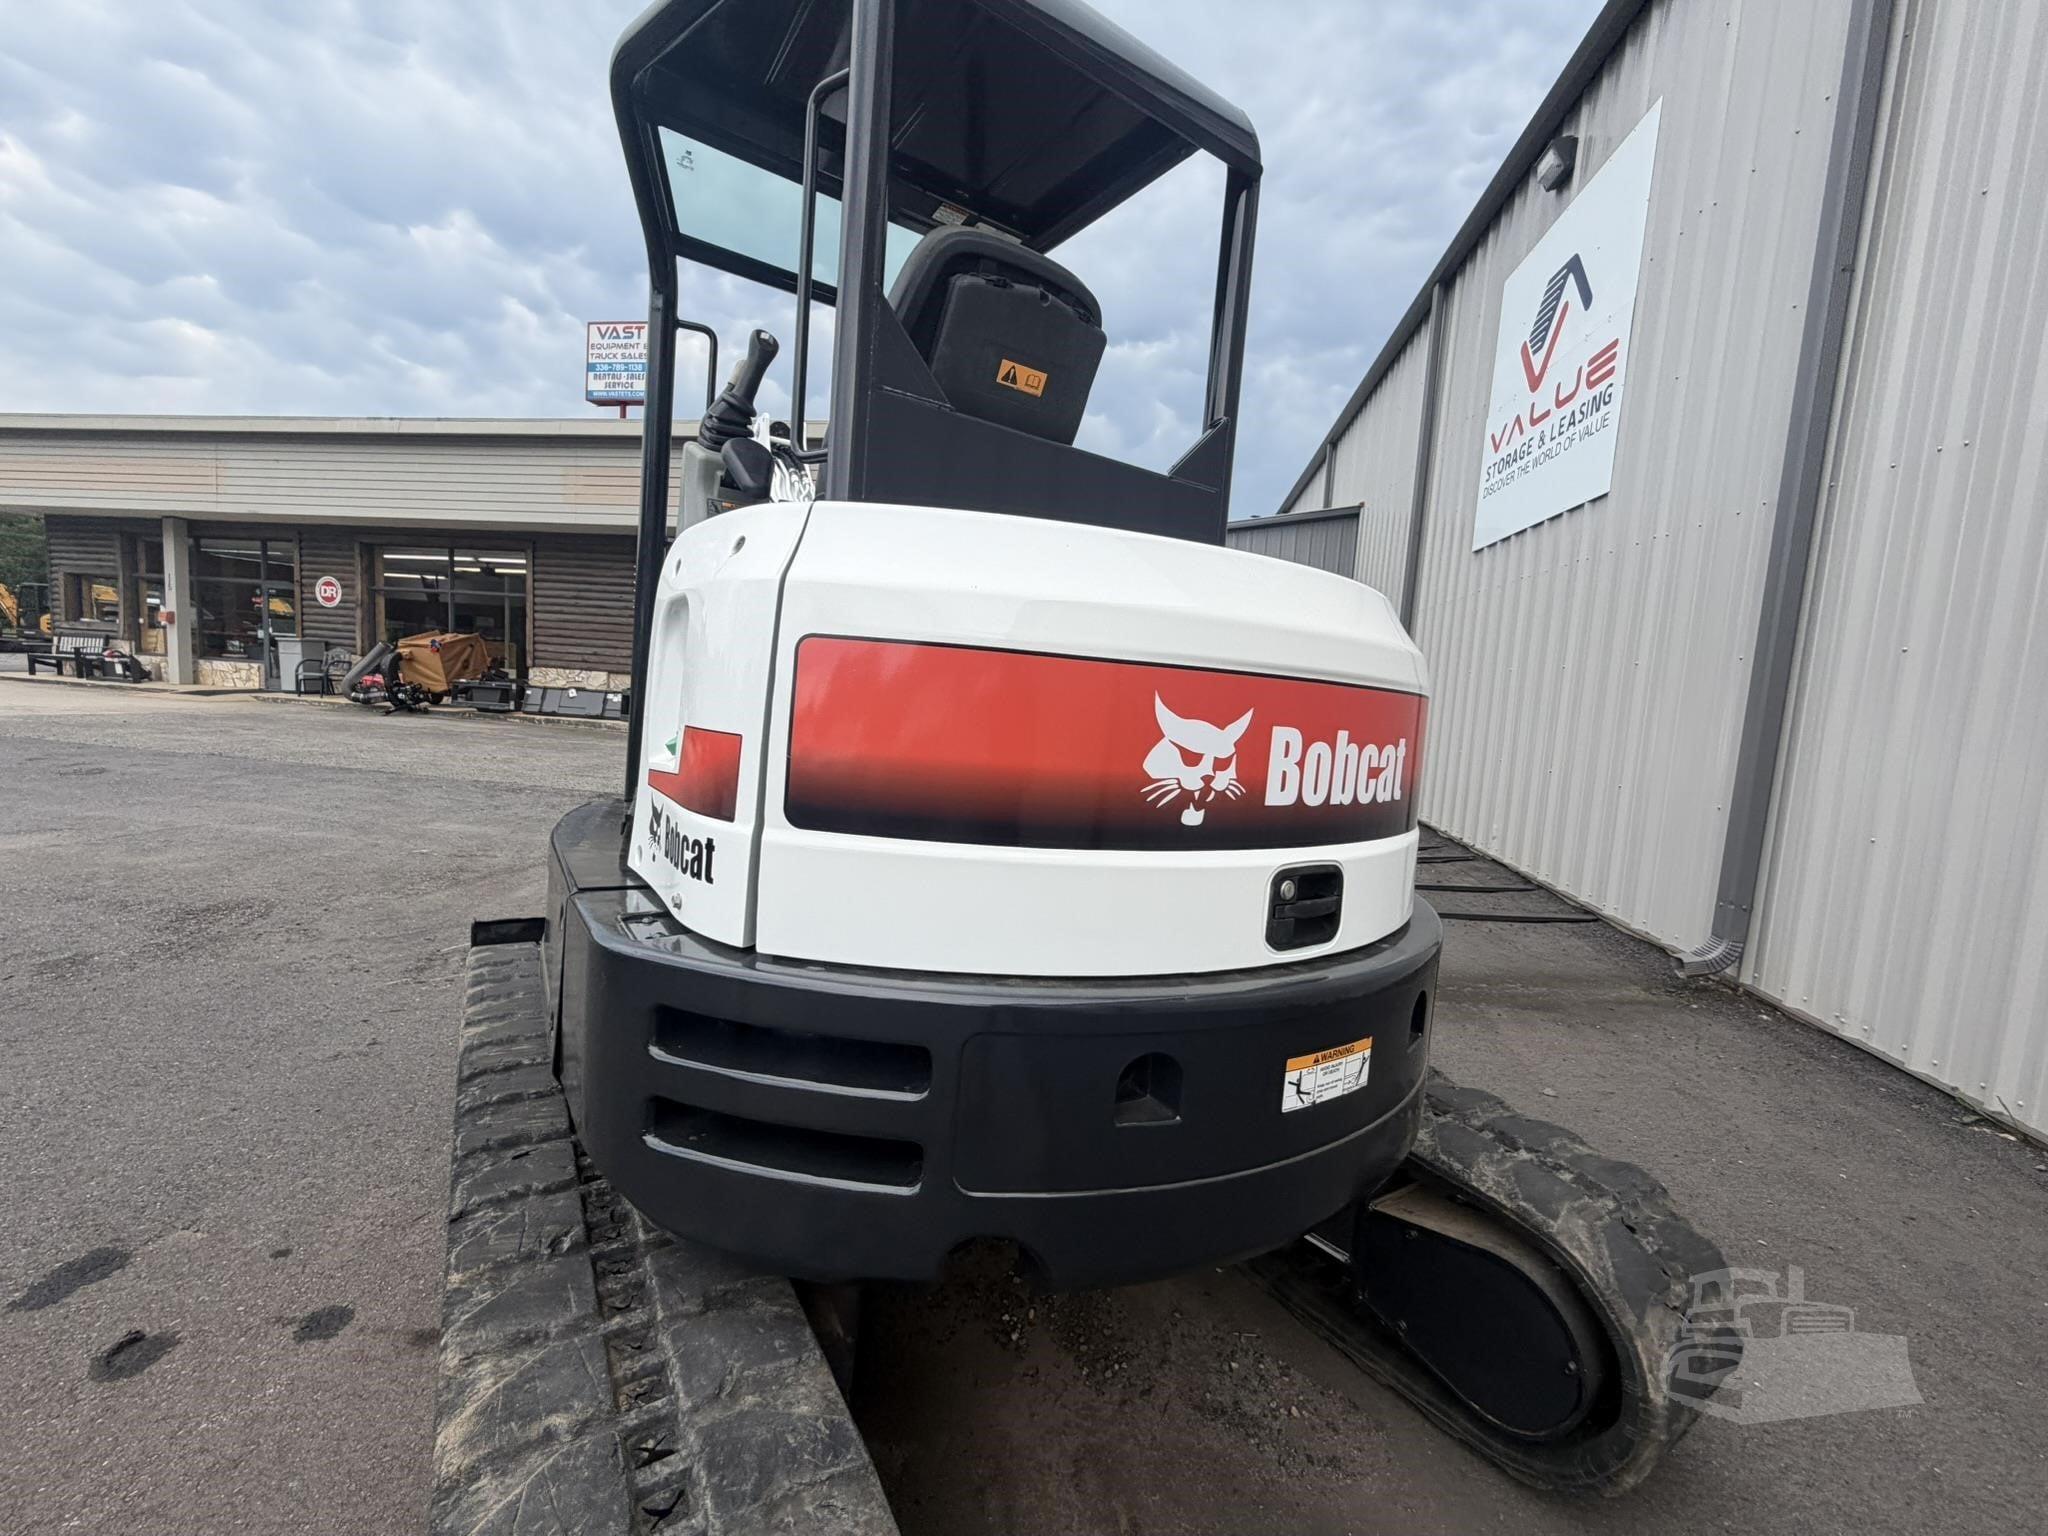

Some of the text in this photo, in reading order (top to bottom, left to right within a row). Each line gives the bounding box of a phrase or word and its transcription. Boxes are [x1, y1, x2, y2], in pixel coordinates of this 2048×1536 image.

[596, 326, 646, 340] VAST
[590, 342, 640, 350] EQUIPMENT
[590, 352, 649, 360] TRUCK SALES
[604, 381, 634, 389] SERVICE
[1491, 338, 1619, 453] VALUE
[1485, 382, 1614, 482] STORAGE & LEASING
[1482, 411, 1610, 499] DISCOVER THE WORLD OF VALUE
[321, 585, 337, 597] DR
[1264, 725, 1406, 807] Bobcat
[664, 813, 715, 885] Bobcat
[1320, 1044, 1355, 1062] WARNING
